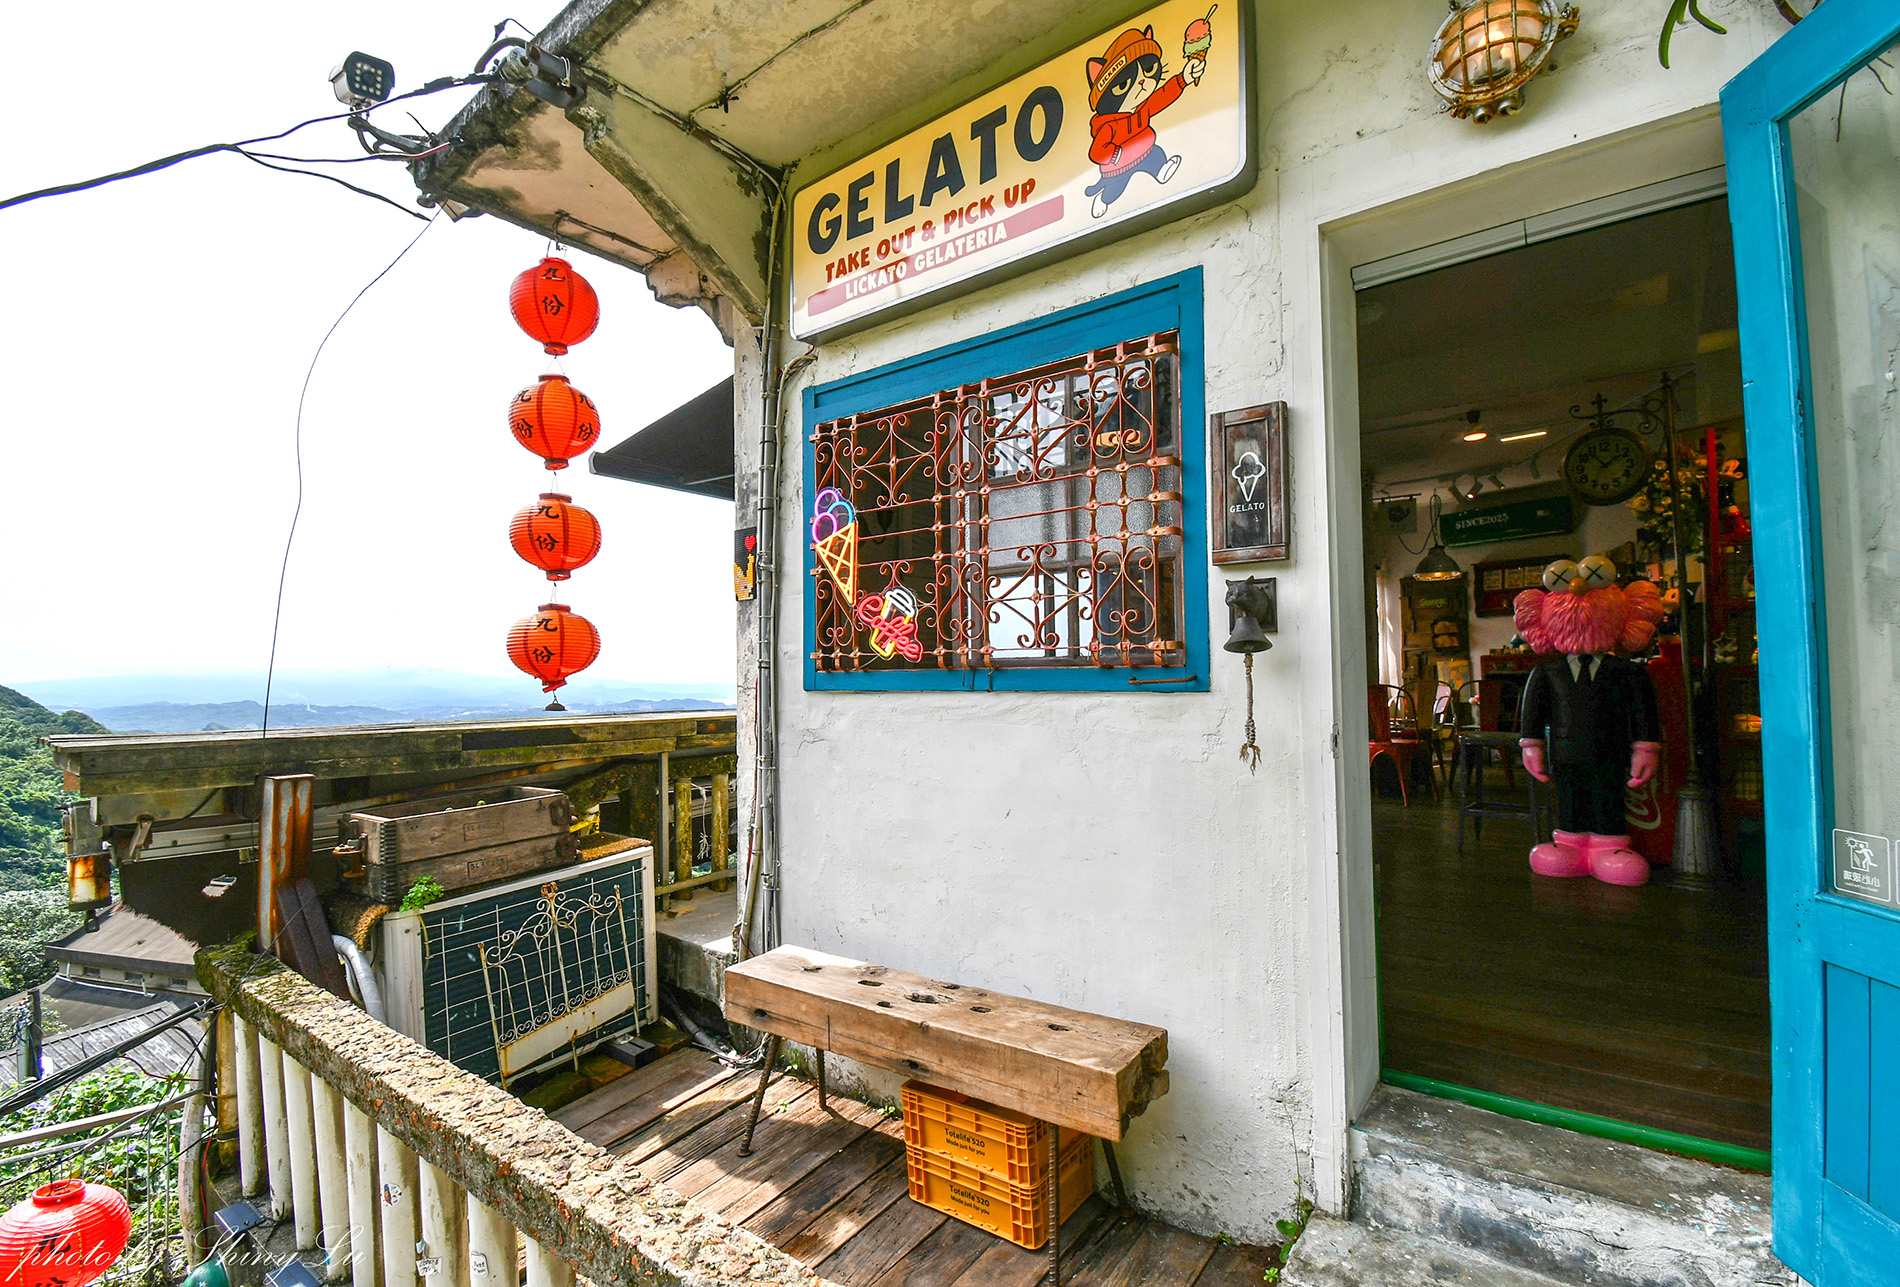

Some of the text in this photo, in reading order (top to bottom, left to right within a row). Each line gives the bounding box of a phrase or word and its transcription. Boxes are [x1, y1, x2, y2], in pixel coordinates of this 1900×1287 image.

[1099, 60, 1124, 88] LICKATO
[807, 86, 1064, 255] GELATO
[825, 178, 1036, 283] TAKE OUT & PICK UP
[845, 222, 1008, 300] LICKATO GELATERIA
[540, 268, 566, 316] 九份
[514, 389, 534, 439] 九份
[578, 393, 595, 442] 九份
[535, 505, 560, 552] 九份
[1229, 502, 1265, 513] GELATO
[532, 618, 558, 664] 九份
[857, 594, 921, 660] Coffee
